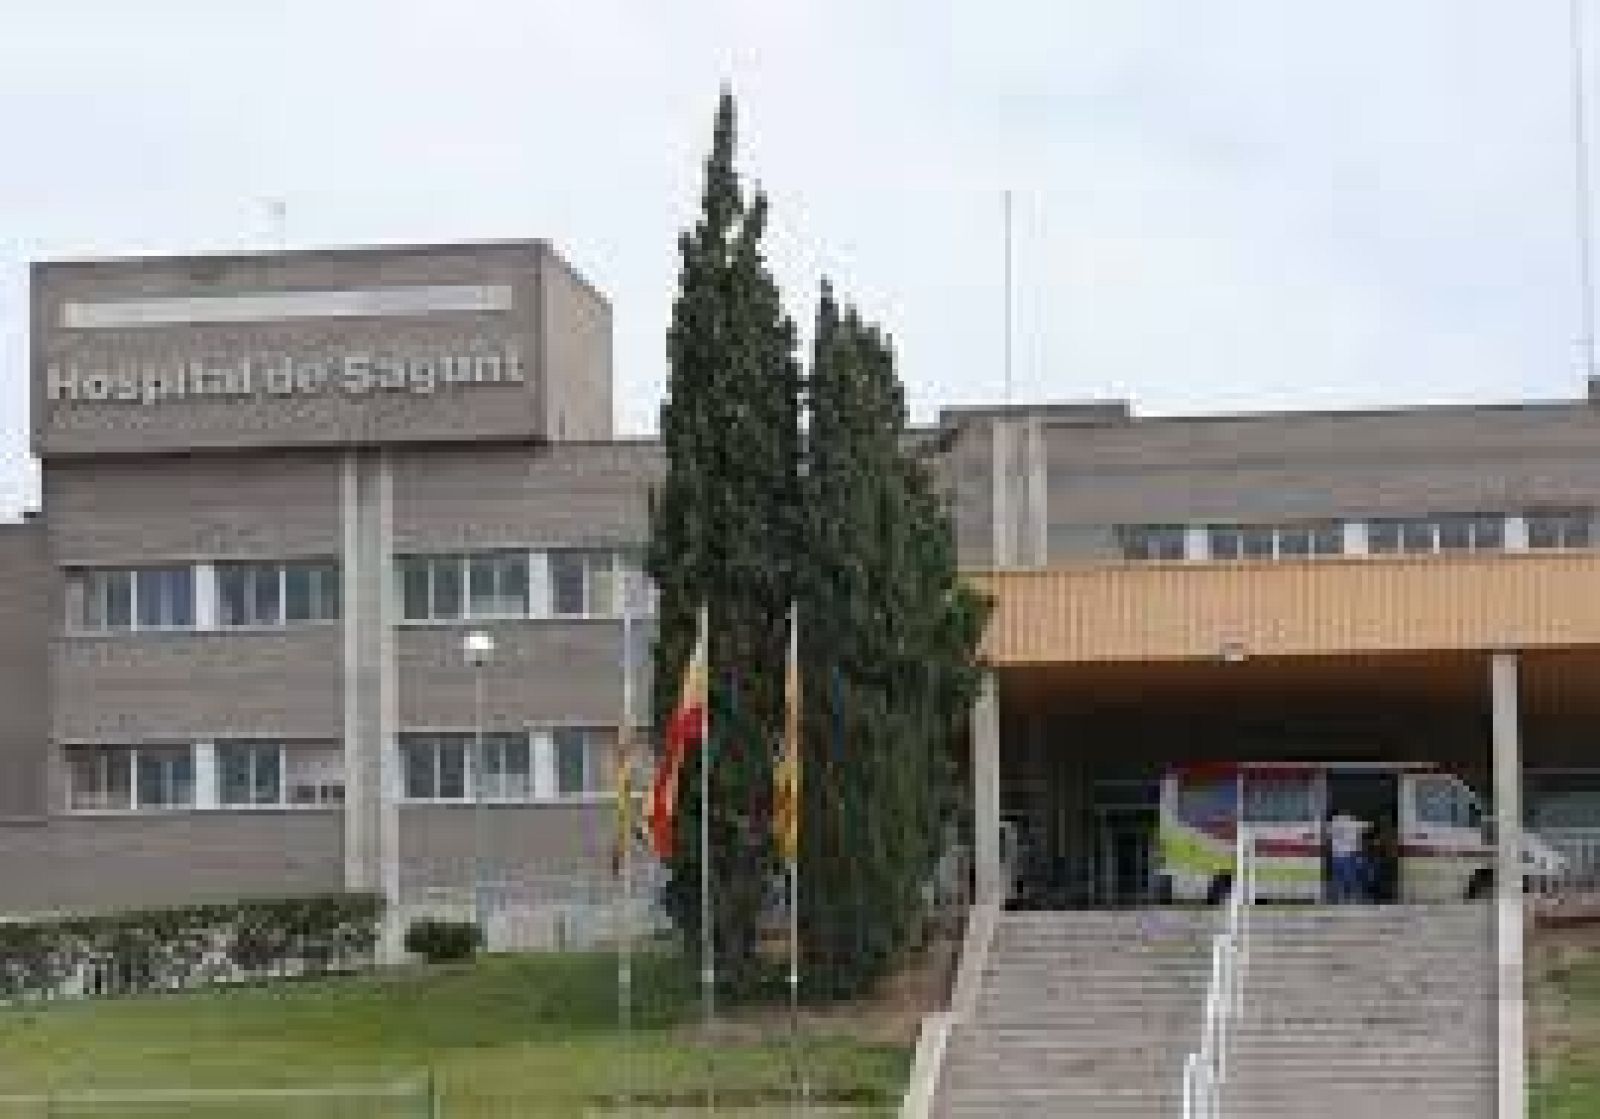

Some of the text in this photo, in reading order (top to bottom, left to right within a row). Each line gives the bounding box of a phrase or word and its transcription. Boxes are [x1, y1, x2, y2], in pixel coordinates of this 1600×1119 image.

[47, 349, 525, 404] Hospital de Sagunt
